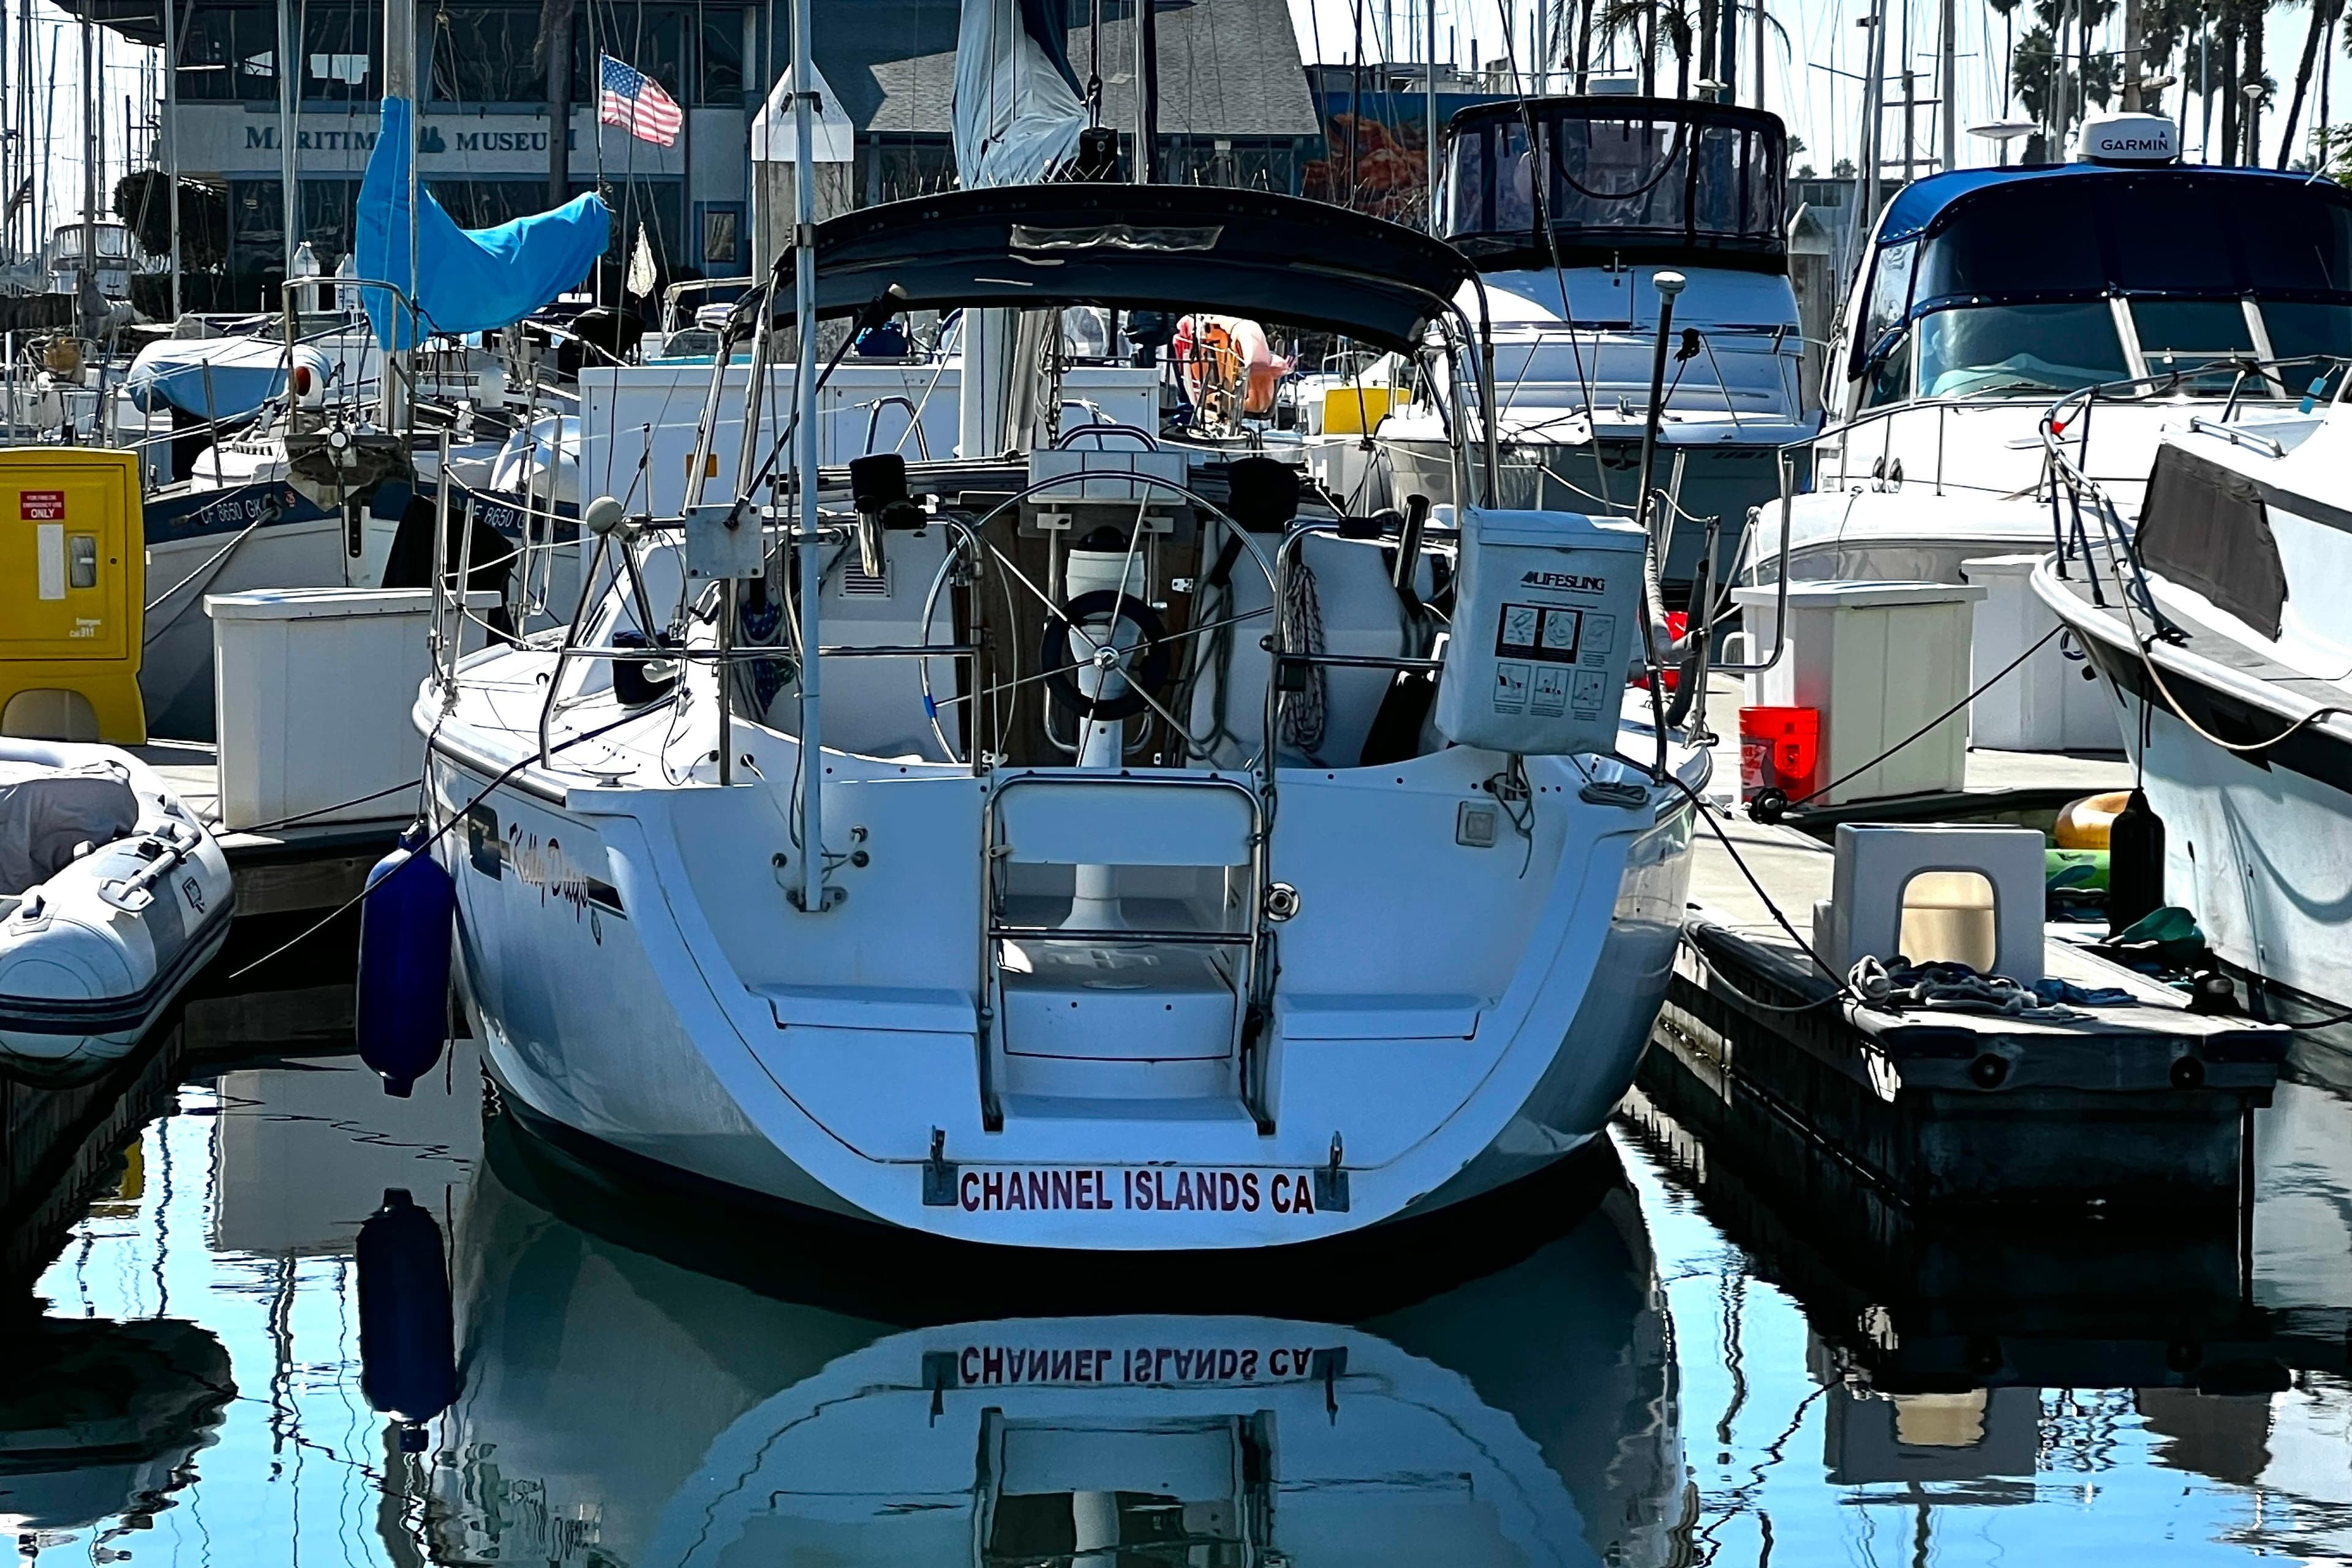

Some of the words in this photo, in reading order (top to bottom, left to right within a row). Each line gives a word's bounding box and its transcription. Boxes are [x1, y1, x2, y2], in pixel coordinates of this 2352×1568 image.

[246, 127, 380, 150] MRITIM
[2101, 138, 2168, 151] GARMIN
[31, 508, 55, 518] ONLY
[217, 502, 243, 522] 8650
[484, 507, 514, 527] 8650
[1532, 571, 1605, 591] LIFESLING
[960, 1170, 1113, 1212] CHANNEL
[1124, 1170, 1260, 1212] ISLANDS
[1270, 1174, 1314, 1214] CA
